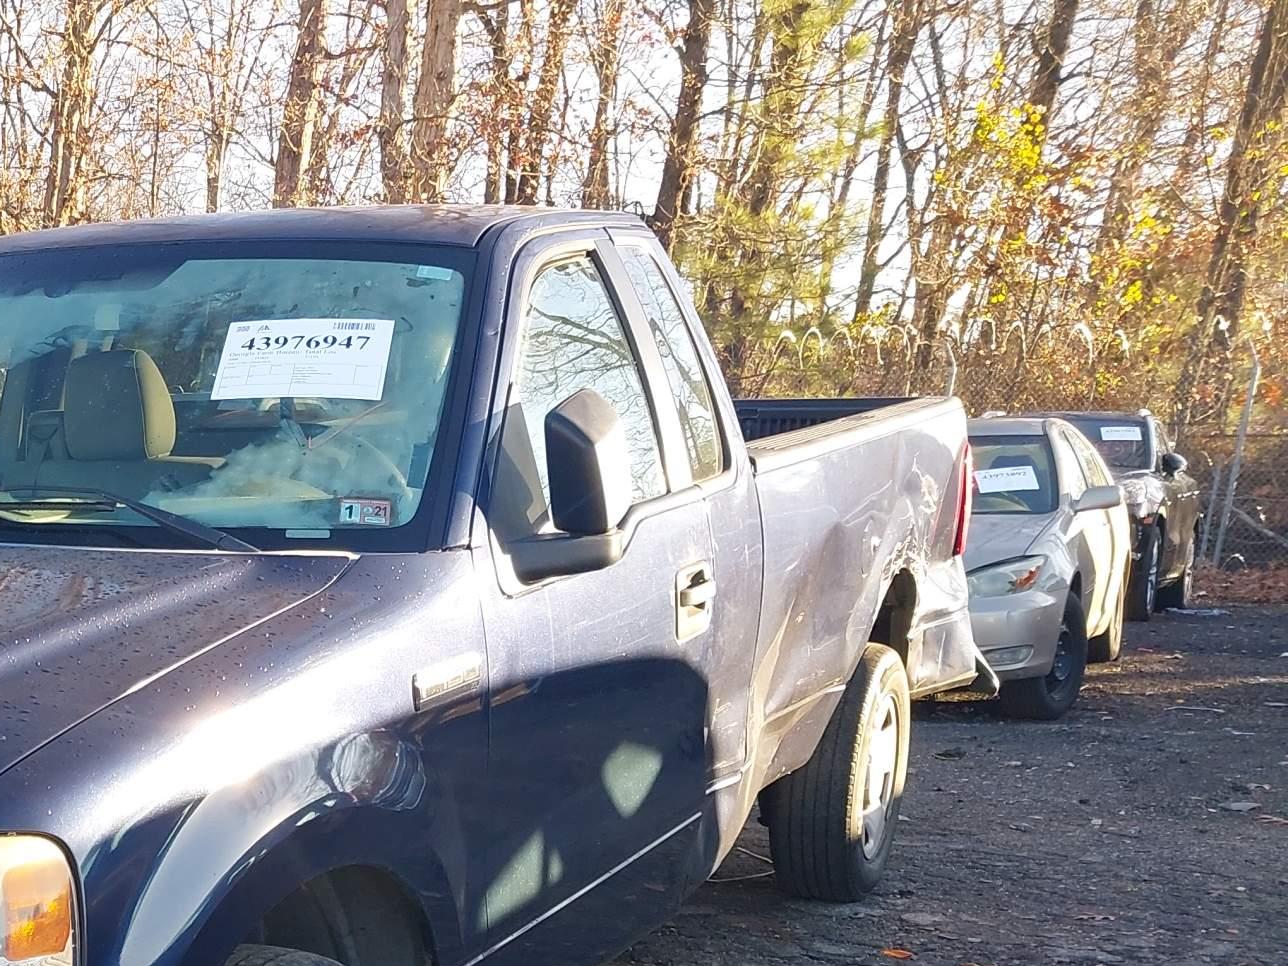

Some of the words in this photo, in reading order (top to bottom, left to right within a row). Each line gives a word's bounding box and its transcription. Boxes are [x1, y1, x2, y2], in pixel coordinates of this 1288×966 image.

[241, 334, 371, 351] 43976947
[344, 504, 354, 520] 1
[374, 505, 388, 517] 21
